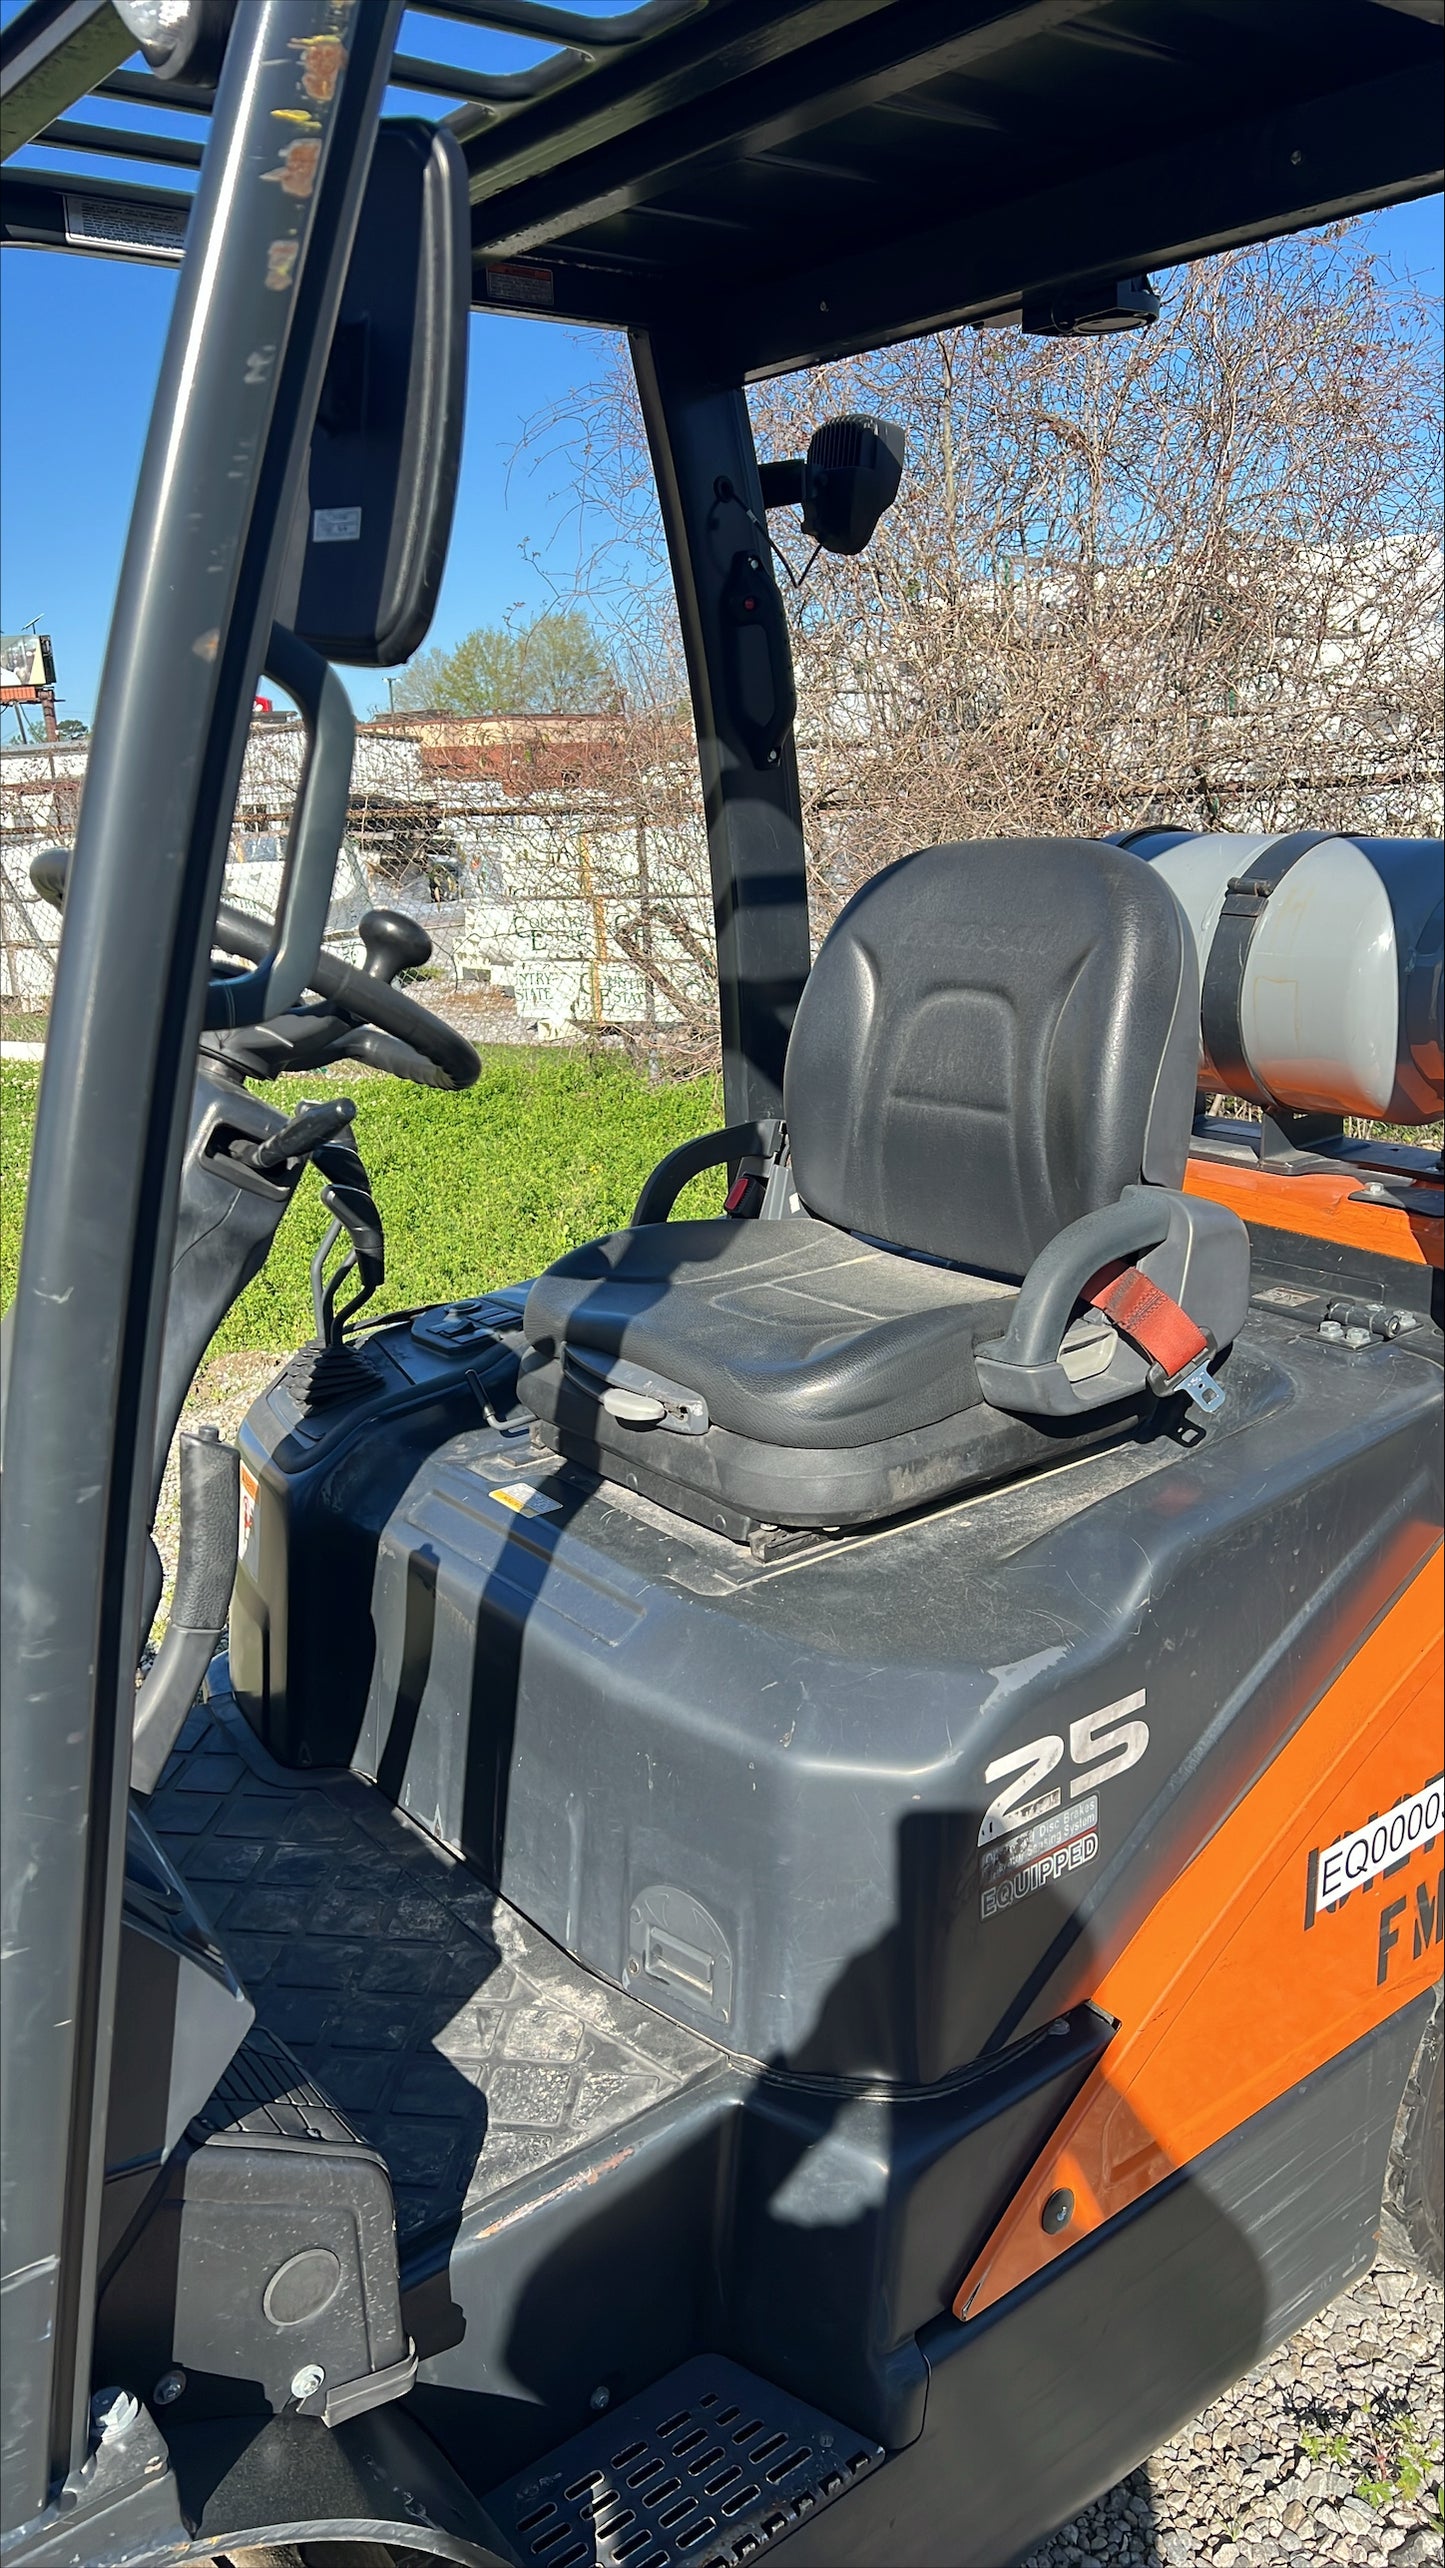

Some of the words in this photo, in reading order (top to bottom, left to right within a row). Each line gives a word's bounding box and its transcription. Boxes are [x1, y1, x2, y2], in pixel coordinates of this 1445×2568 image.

[977, 1687, 1150, 1848] 25
[1039, 1818, 1061, 1838] Disc
[1063, 1800, 1095, 1824] Brakes
[1063, 1812, 1096, 1838] System
[1322, 1791, 1444, 1898] EQ0000
[981, 1831, 1098, 1919] EQUIPPED
